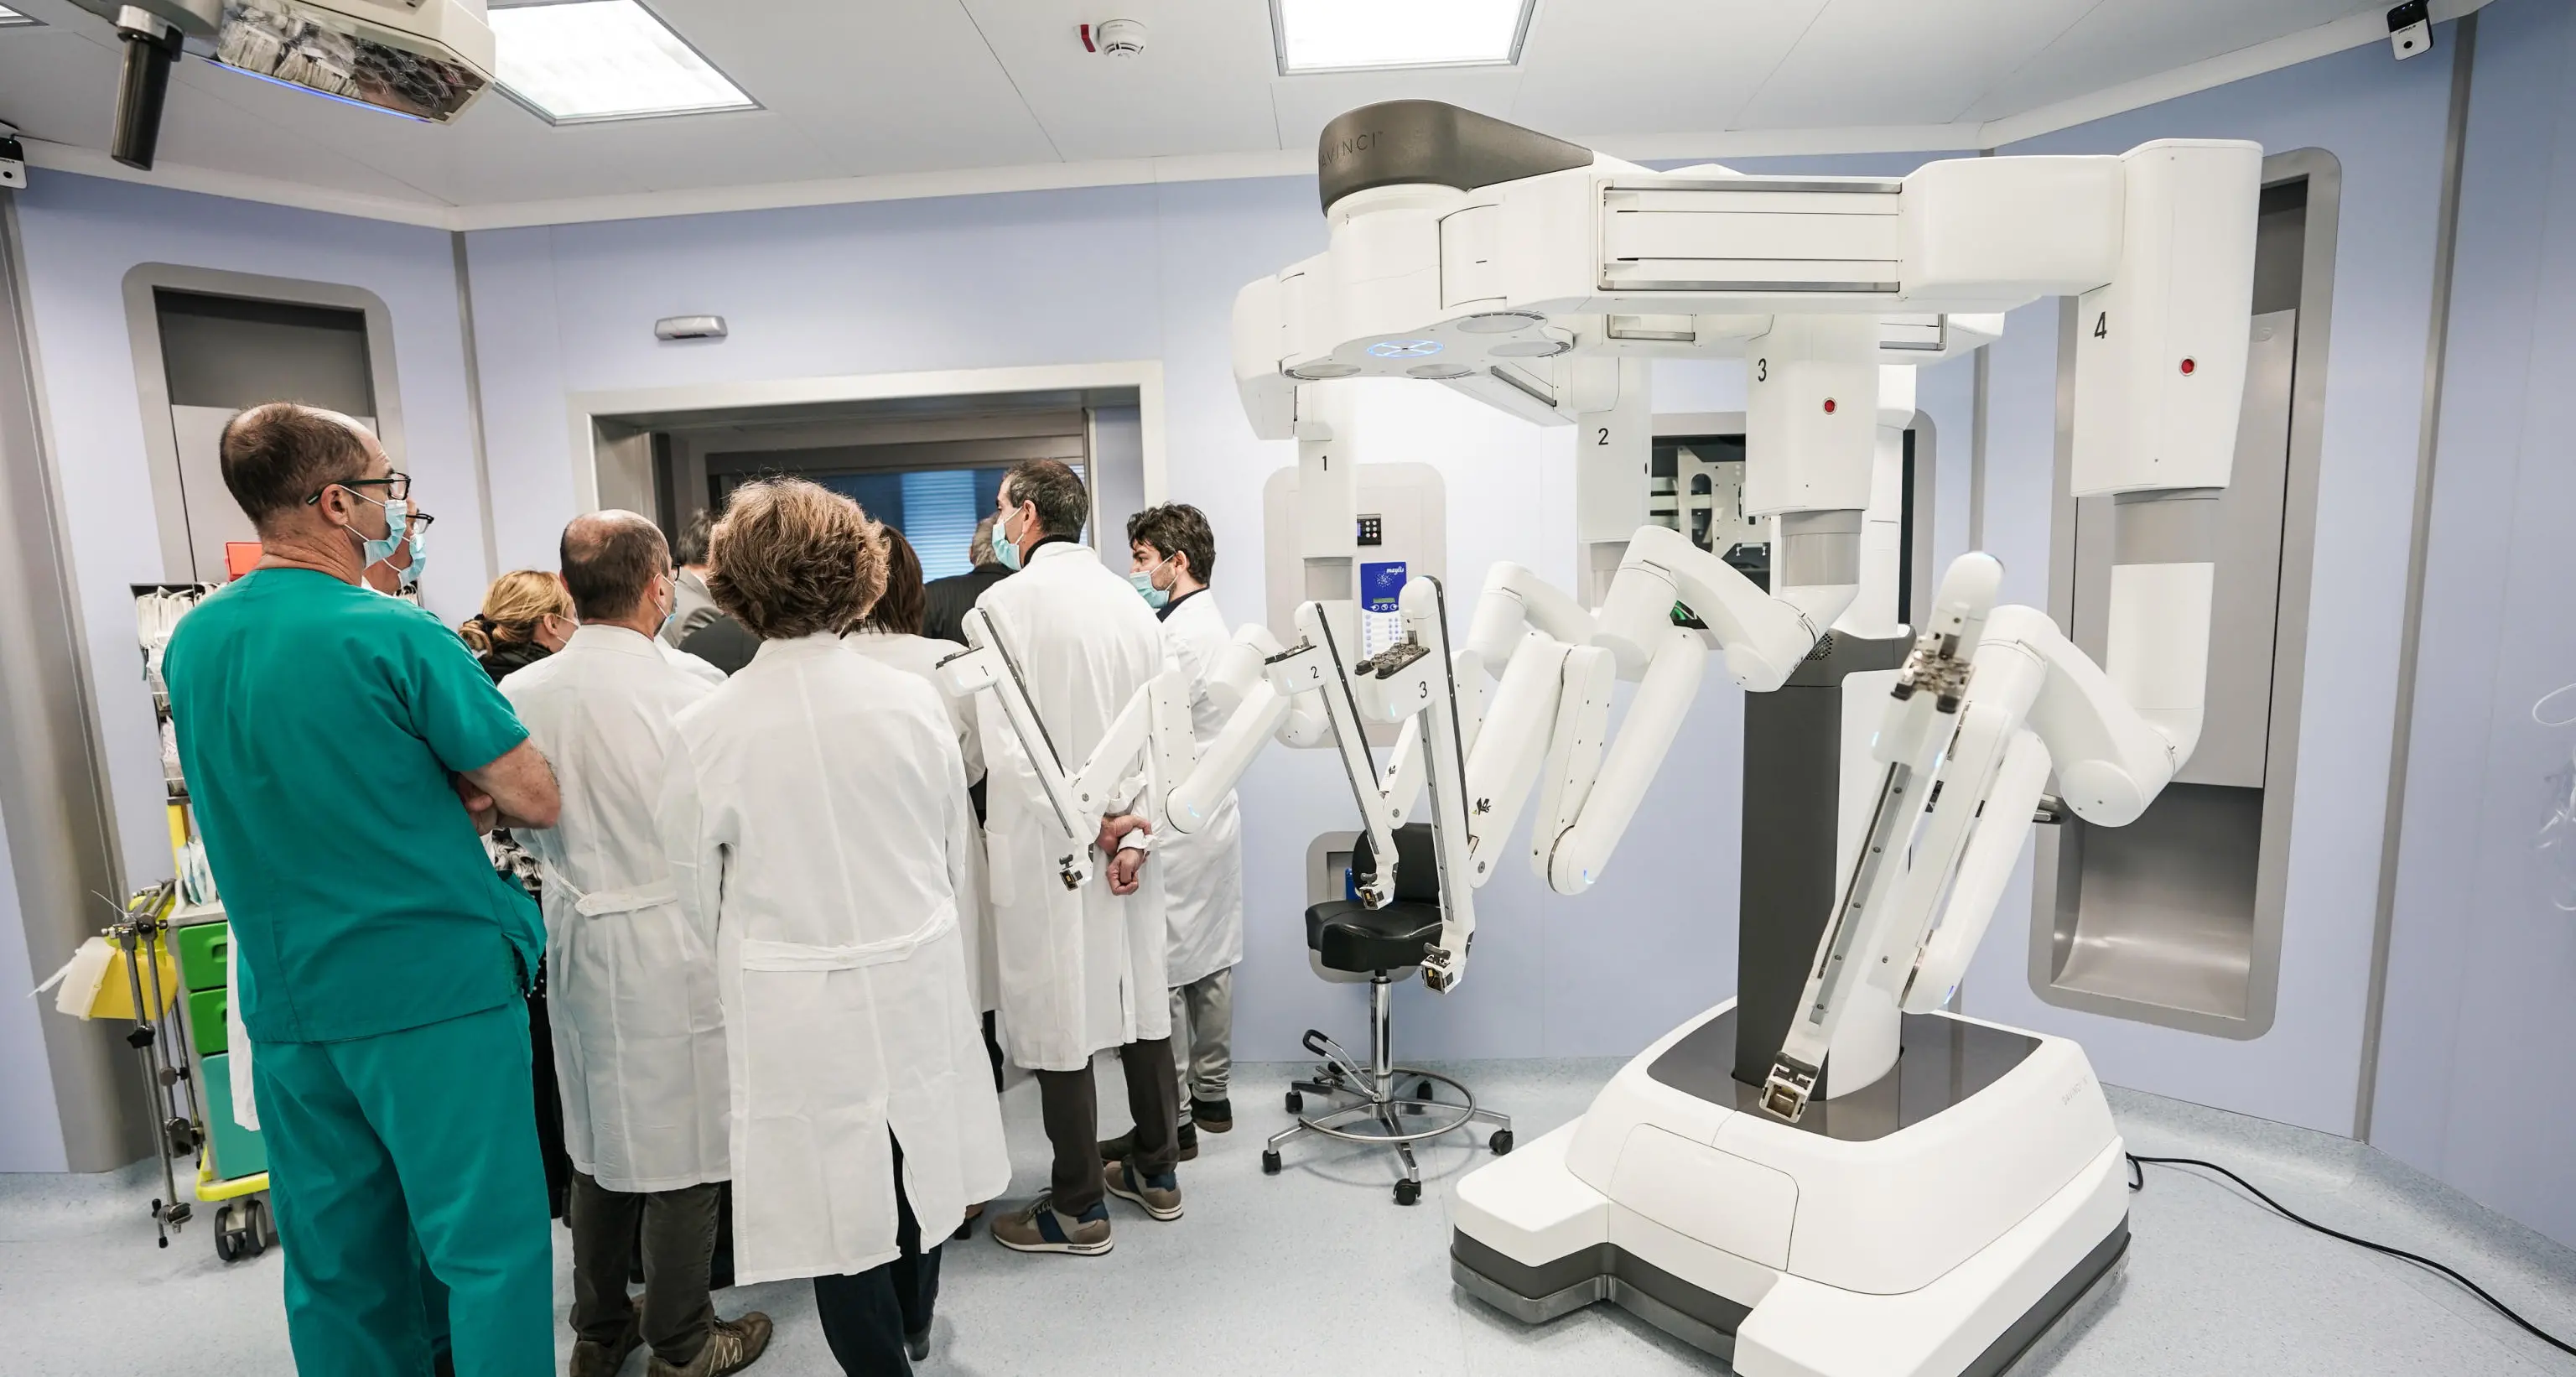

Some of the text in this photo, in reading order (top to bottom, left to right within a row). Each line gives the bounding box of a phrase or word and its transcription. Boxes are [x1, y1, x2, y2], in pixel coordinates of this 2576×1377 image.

[2094, 311, 2107, 340] 4
[1758, 357, 1767, 382] 3
[1598, 428, 1609, 445] 2
[1322, 455, 1327, 471] 1
[980, 665, 989, 677] 1
[1311, 666, 1319, 679] 2
[1419, 681, 1428, 699] 3
